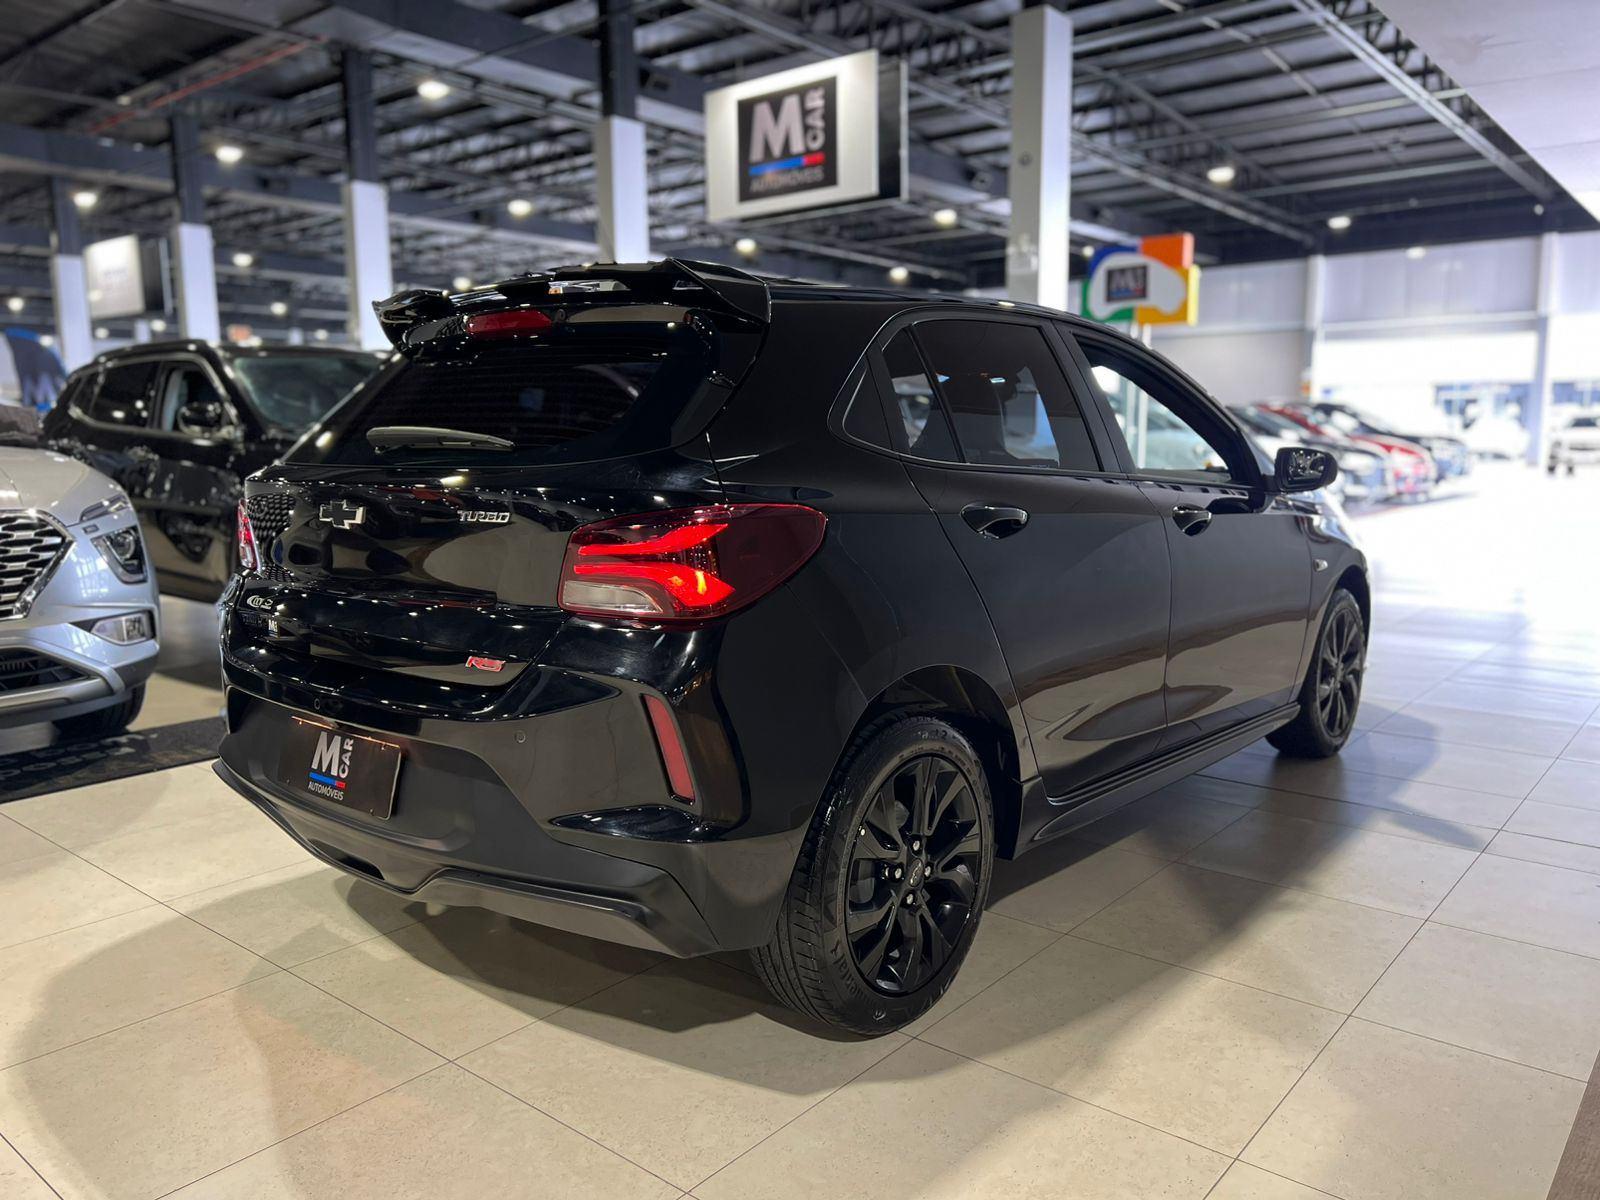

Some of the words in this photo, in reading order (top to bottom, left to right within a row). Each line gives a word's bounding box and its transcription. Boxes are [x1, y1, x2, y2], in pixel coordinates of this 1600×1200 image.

[749, 94, 806, 163] M
[804, 86, 825, 150] CAR
[456, 509, 510, 523] TURBO
[465, 656, 507, 673] RS
[311, 731, 342, 777] M
[338, 738, 354, 779] CAR
[308, 781, 344, 801] AUTOMÓVEIS
